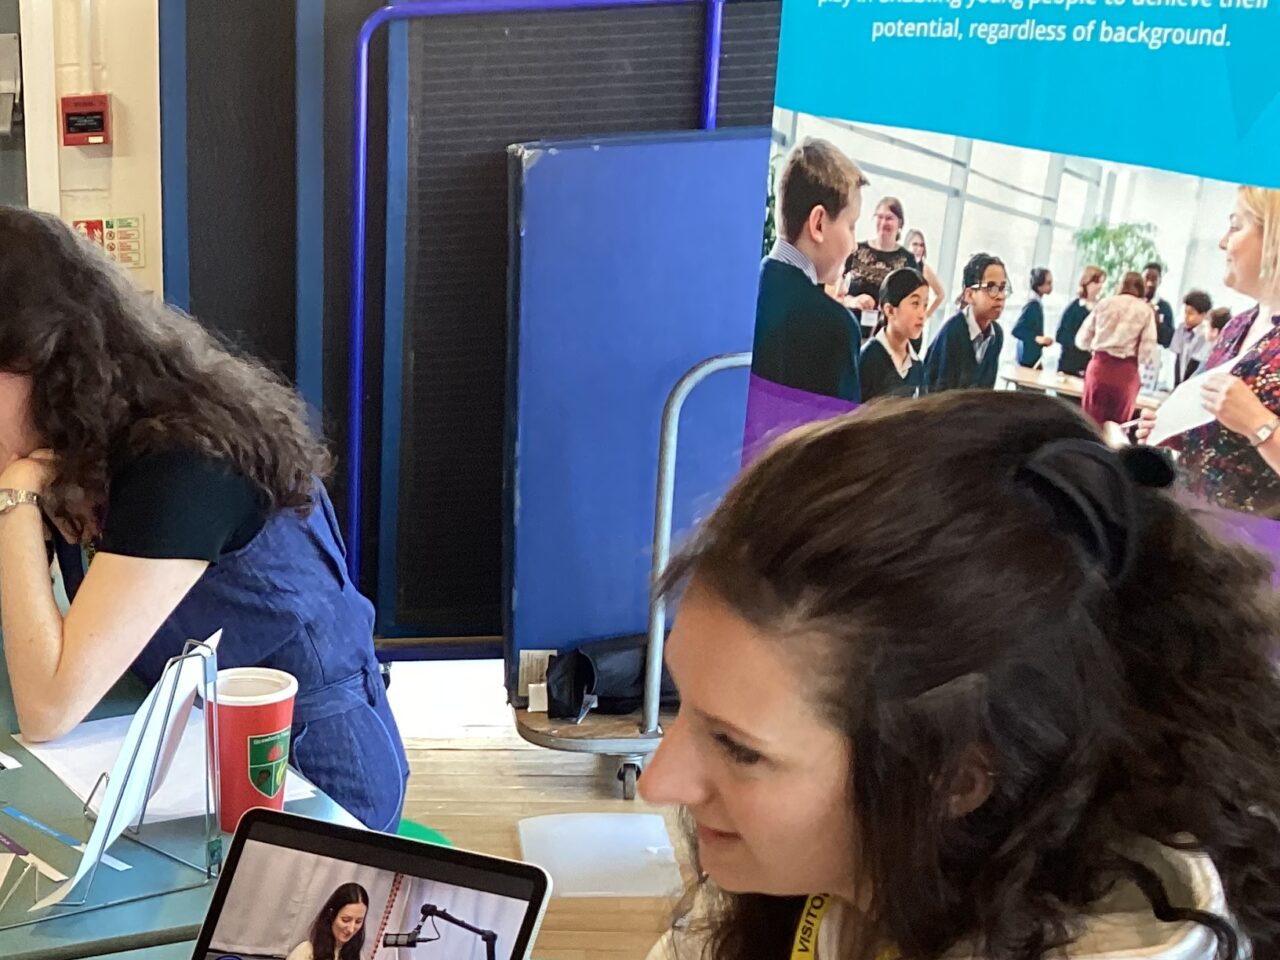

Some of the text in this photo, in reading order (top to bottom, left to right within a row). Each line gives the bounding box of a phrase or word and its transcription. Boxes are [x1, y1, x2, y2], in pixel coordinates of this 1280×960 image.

[872, 17, 1231, 50] potential, regardless of background.
[797, 893, 830, 952] VISITO
